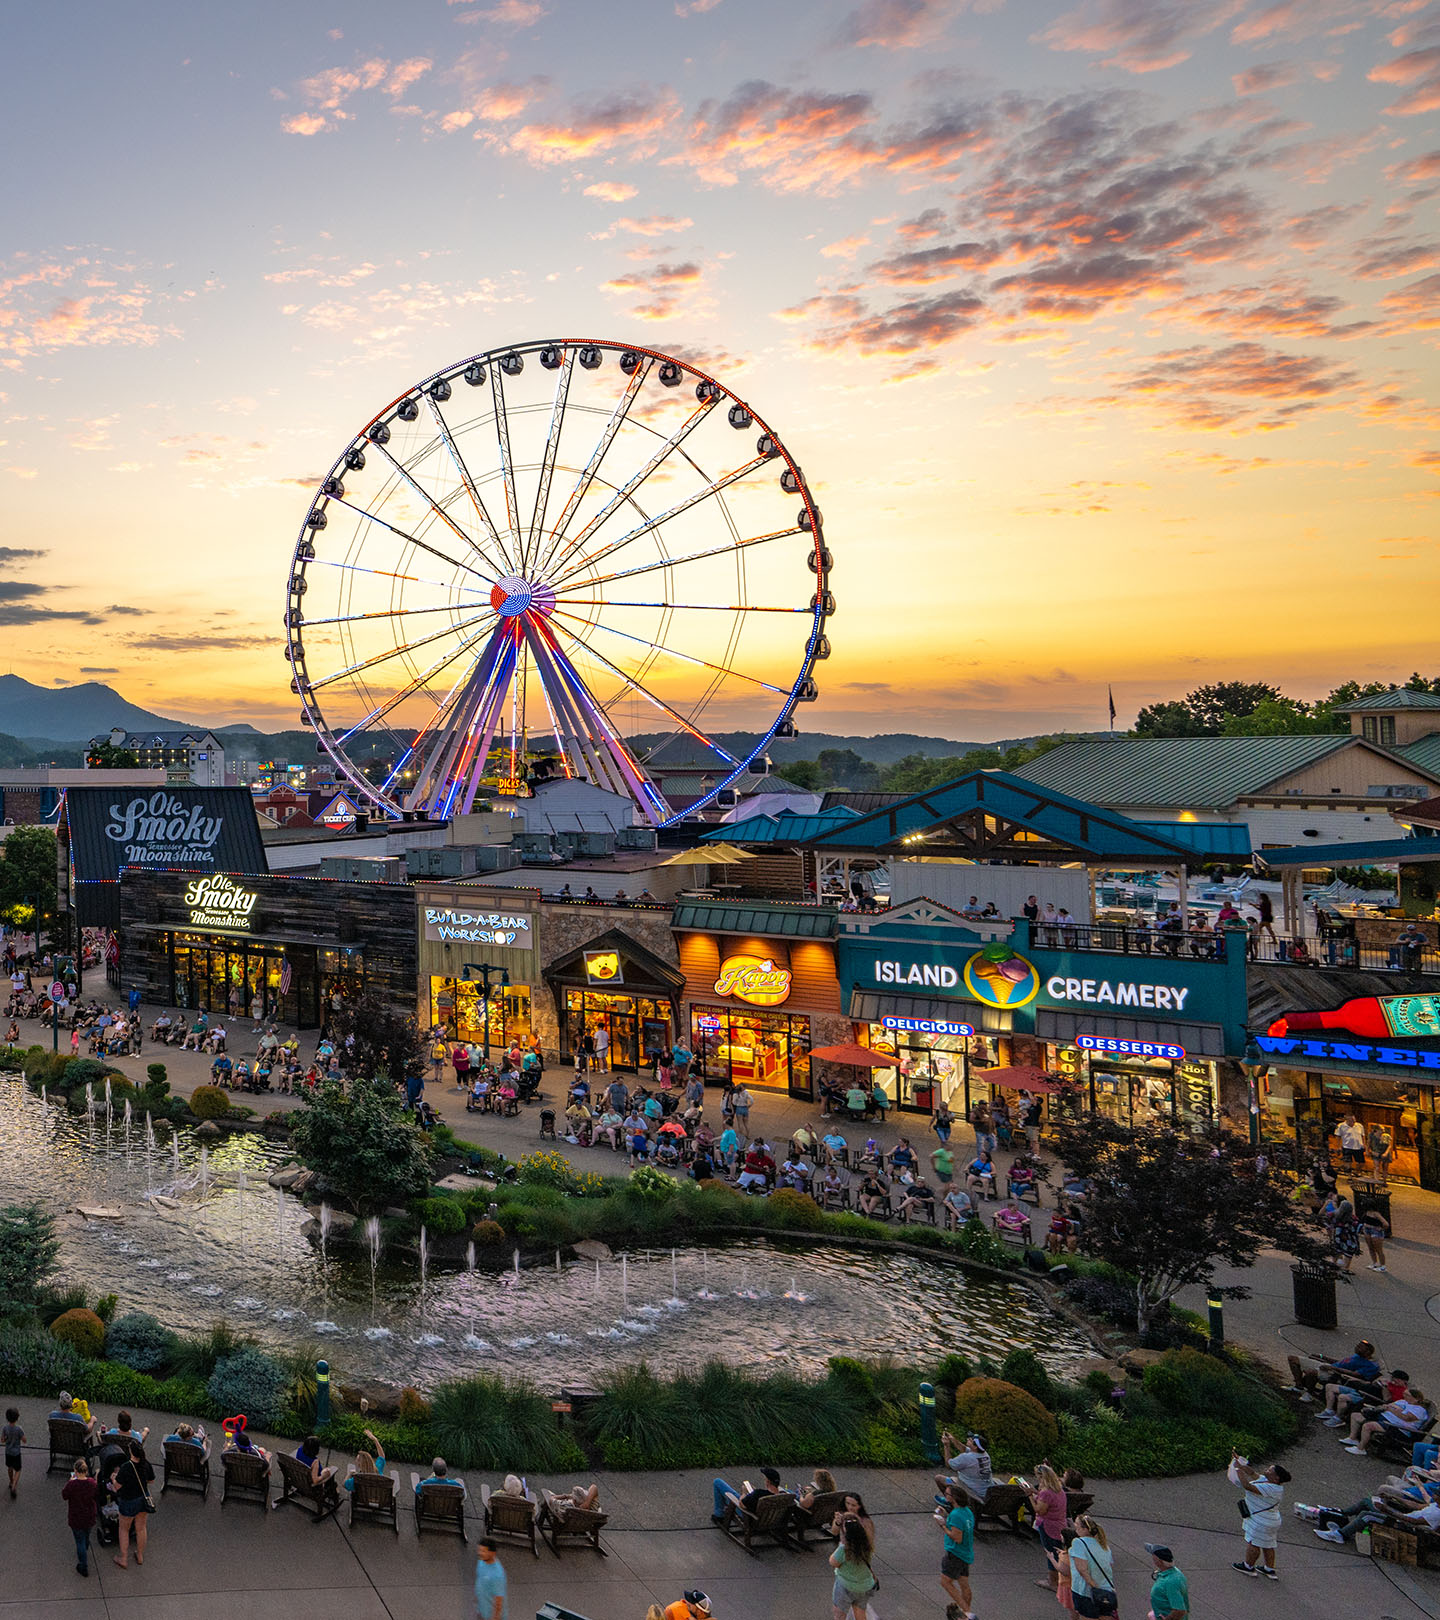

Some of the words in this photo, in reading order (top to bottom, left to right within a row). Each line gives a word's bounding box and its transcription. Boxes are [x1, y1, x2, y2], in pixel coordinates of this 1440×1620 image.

[149, 791, 190, 817] Ole
[105, 798, 223, 848] Smoky
[125, 844, 214, 862] Moonshine
[212, 874, 235, 892] Ole
[184, 878, 257, 915] Smoky
[190, 910, 250, 928] Moonshine
[438, 925, 516, 945] WORKSHOP
[875, 961, 958, 988] ISLAND
[1047, 976, 1188, 1011] CREAMERY
[886, 1018, 969, 1035] DELICIOUS
[1082, 1037, 1178, 1057] DESSERTS
[1185, 1065, 1206, 1075] Hot
